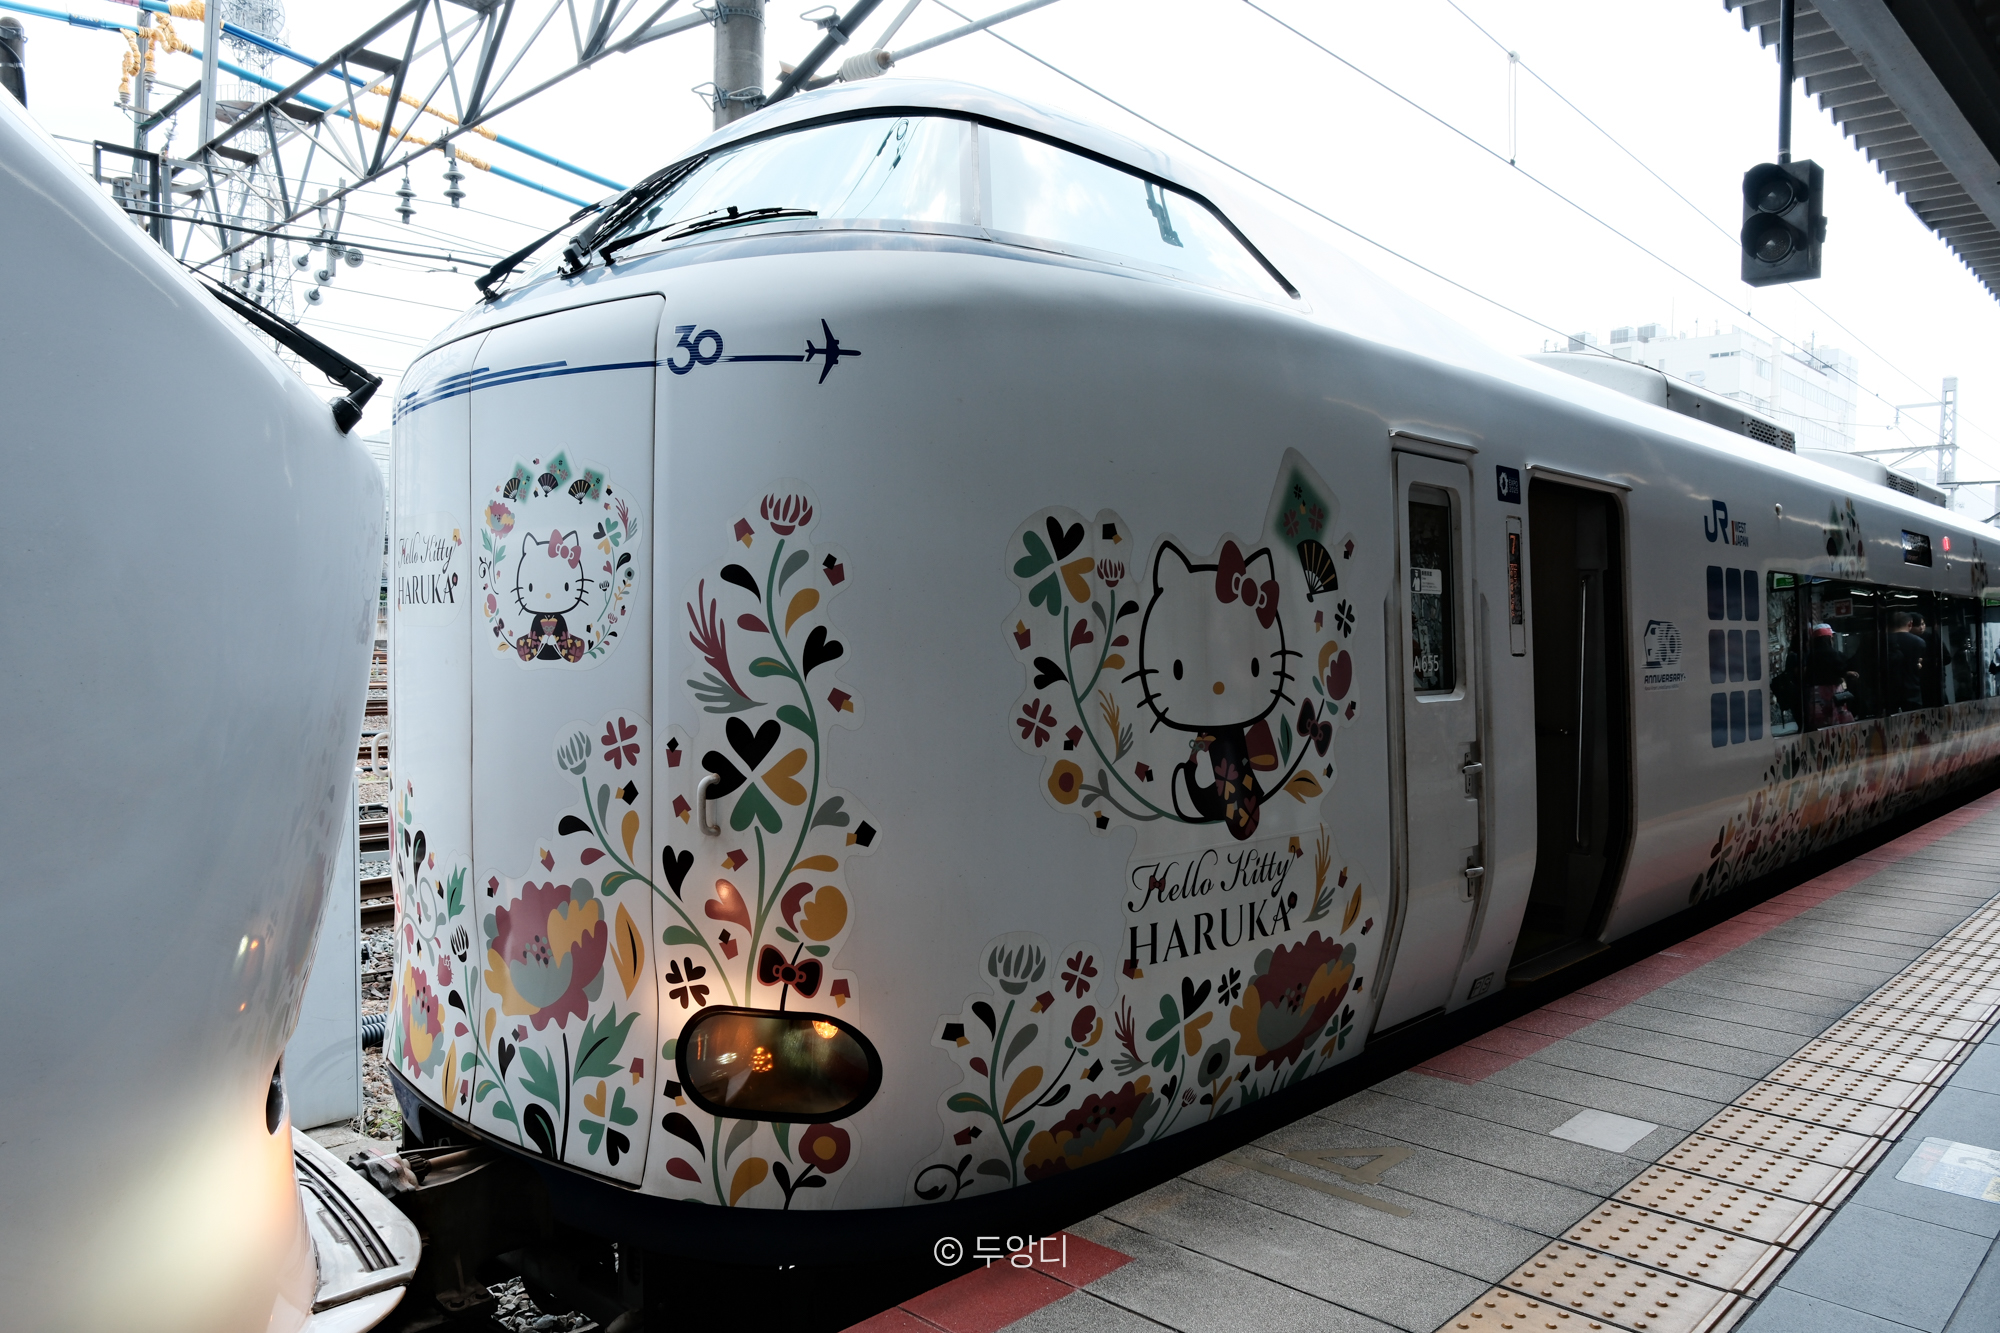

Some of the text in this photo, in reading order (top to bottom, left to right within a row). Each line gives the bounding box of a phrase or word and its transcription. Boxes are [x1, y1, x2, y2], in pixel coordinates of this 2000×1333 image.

[667, 325, 724, 375] 30
[1704, 500, 1729, 544] JR
[1735, 521, 1747, 533] WEST
[1735, 534, 1749, 547] JAPAN
[398, 531, 458, 574] Hello Kitty
[398, 573, 457, 605] HARUKA
[1644, 672, 1685, 684] ANNIVERSARY
[1127, 844, 1296, 913] Hello Kitty
[1129, 893, 1296, 969] HARUKA
